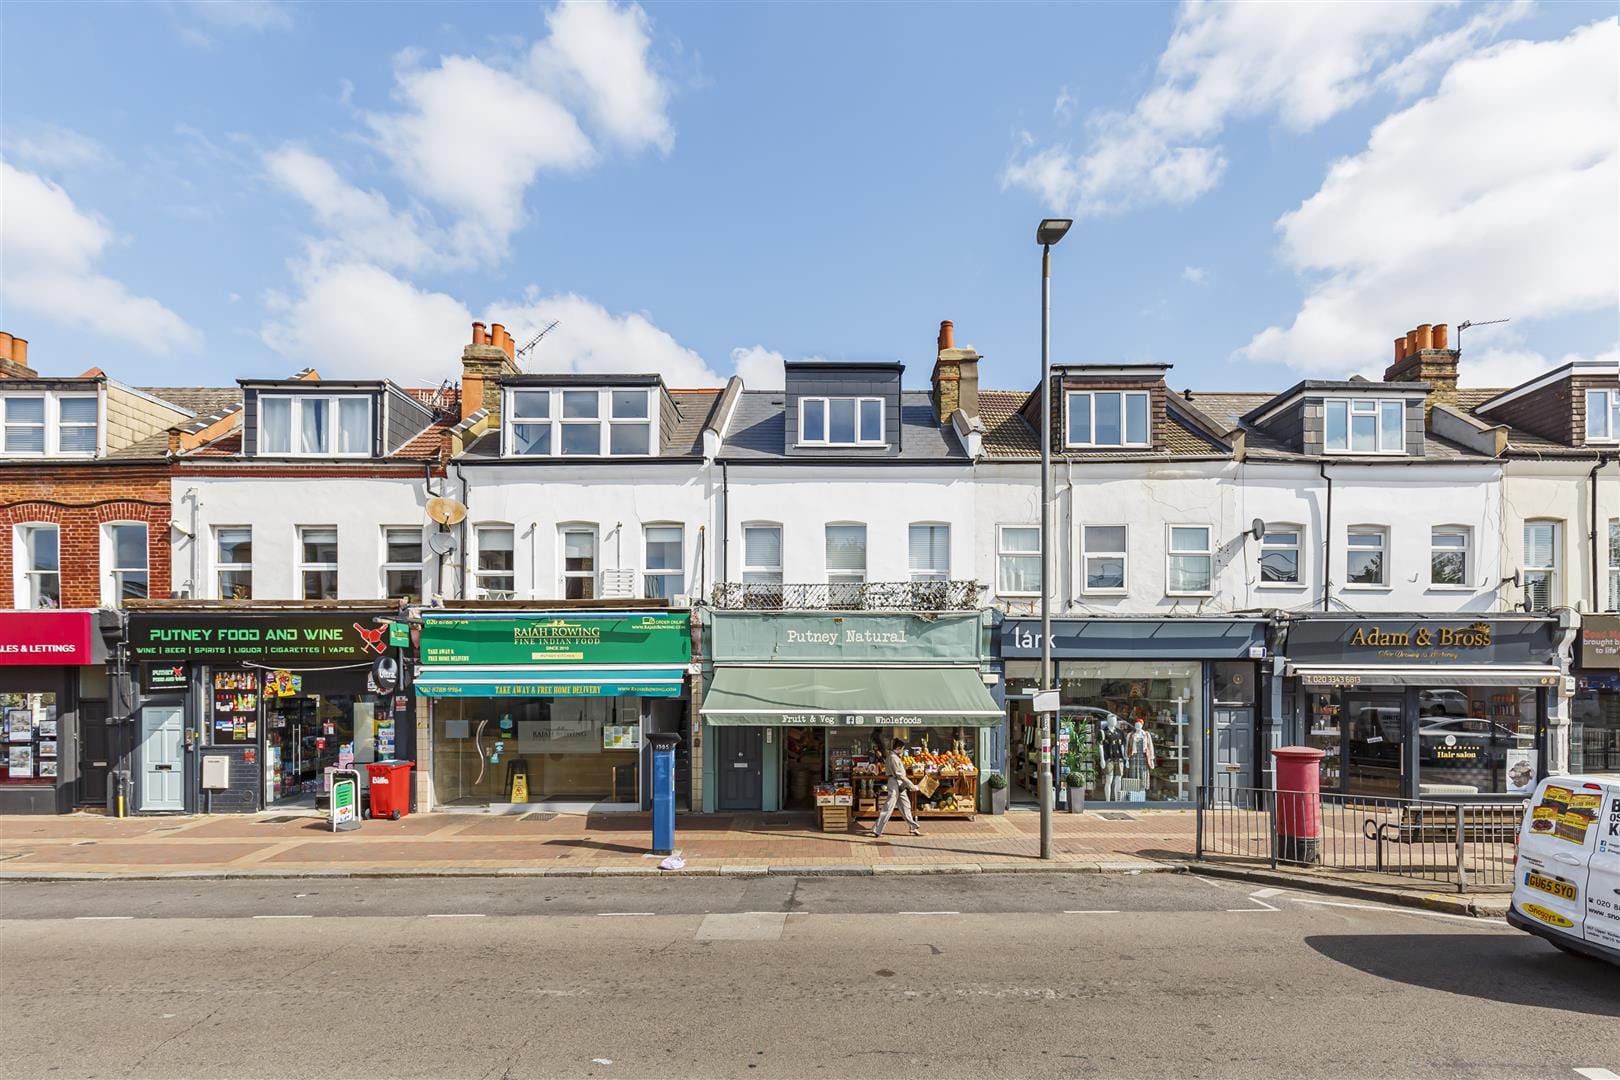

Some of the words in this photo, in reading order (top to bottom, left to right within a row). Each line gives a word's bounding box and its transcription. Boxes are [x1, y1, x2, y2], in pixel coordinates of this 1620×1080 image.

[149, 629, 213, 641] PUTNEY
[217, 629, 260, 641] FOOD
[265, 629, 298, 641] AND
[303, 629, 343, 641] WINE
[514, 627, 548, 636] RAJAH
[552, 627, 600, 636] ROWING
[787, 630, 839, 646] Putney
[846, 630, 907, 643] Natural
[1350, 626, 1410, 647] Adam
[1415, 627, 1433, 646] &
[1439, 627, 1493, 646] Bross
[495, 686, 511, 694] TAKE
[513, 686, 530, 694] AWAY
[537, 686, 552, 694] FREE
[572, 686, 601, 694] DELIVERY
[782, 715, 807, 723] Fruit
[809, 715, 816, 723] &
[819, 715, 835, 725] Veg
[875, 716, 922, 724] Wholefoods
[1596, 899, 1611, 908] 020
